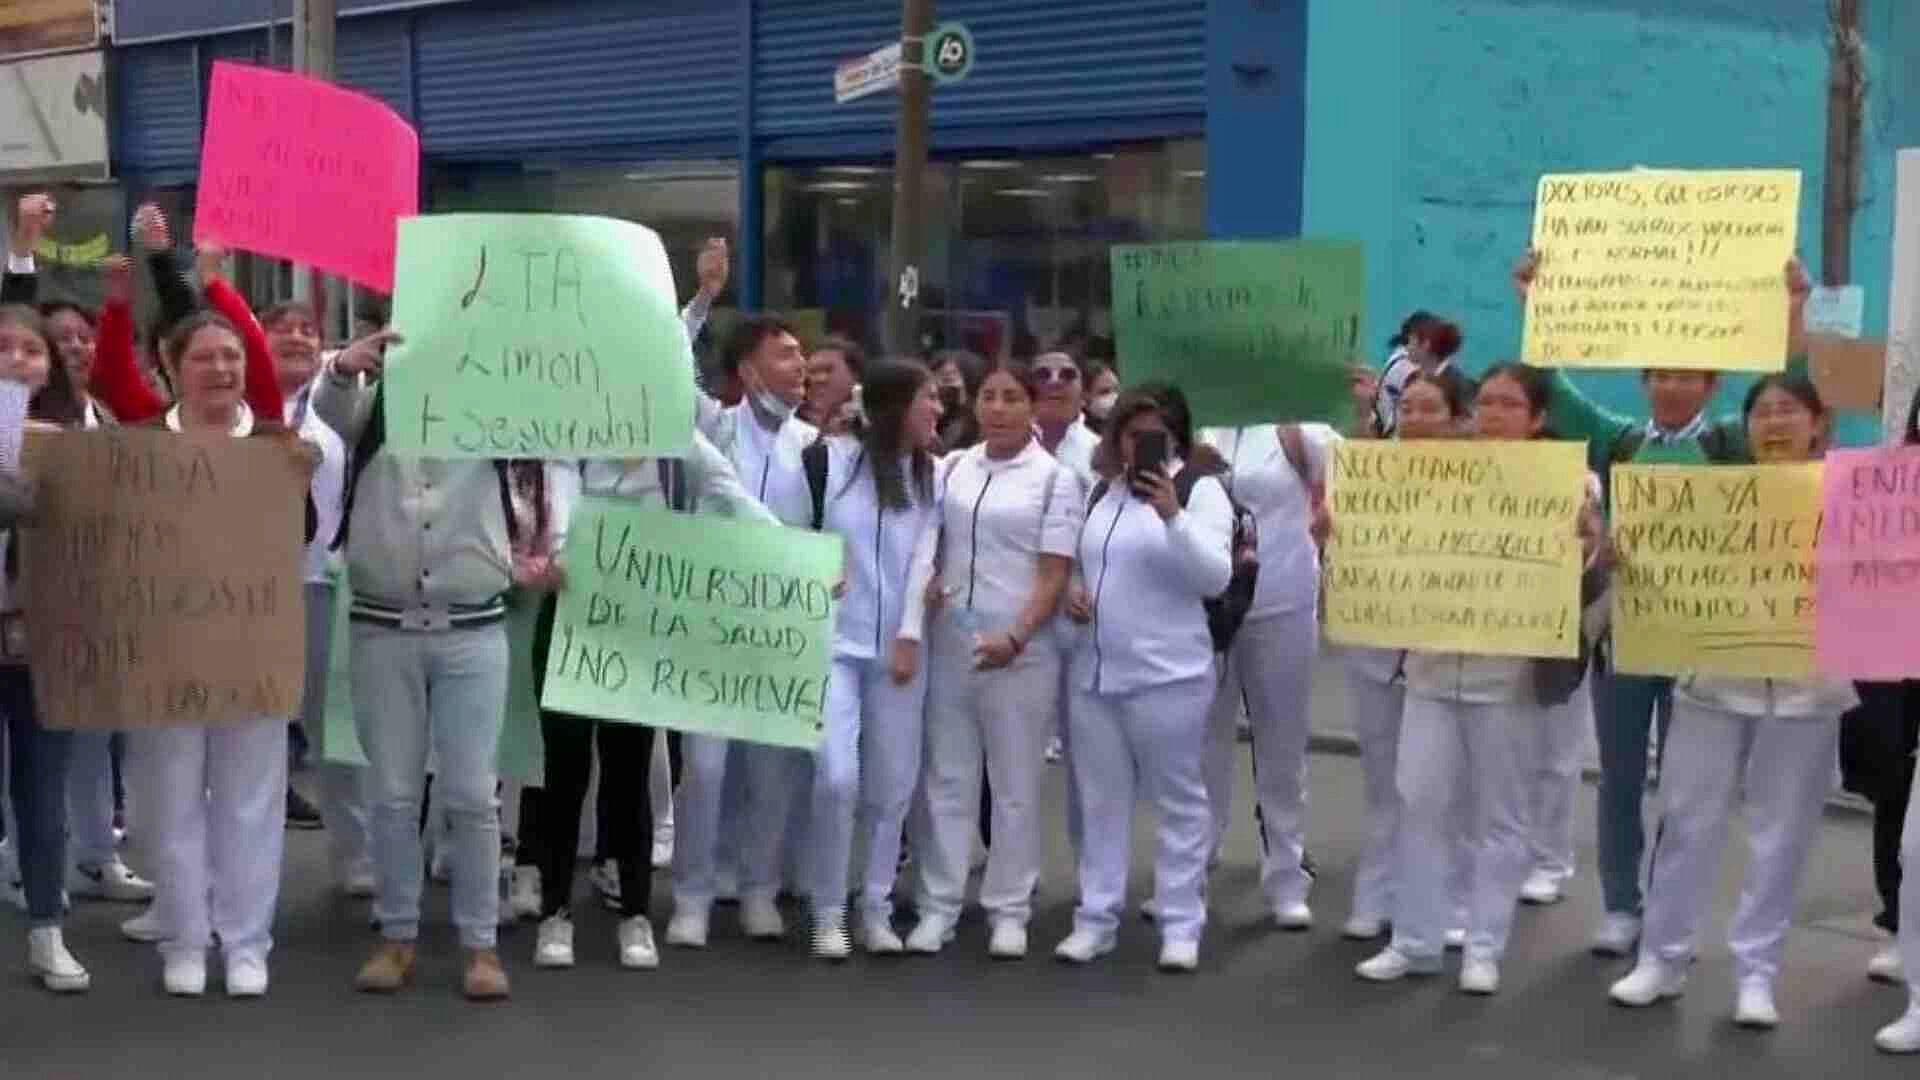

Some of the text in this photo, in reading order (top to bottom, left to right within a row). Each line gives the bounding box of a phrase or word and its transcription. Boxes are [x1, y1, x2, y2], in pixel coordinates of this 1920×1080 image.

[595, 513, 831, 621] UNIVERSIDAD
[588, 591, 808, 658] DE LA SALUD
